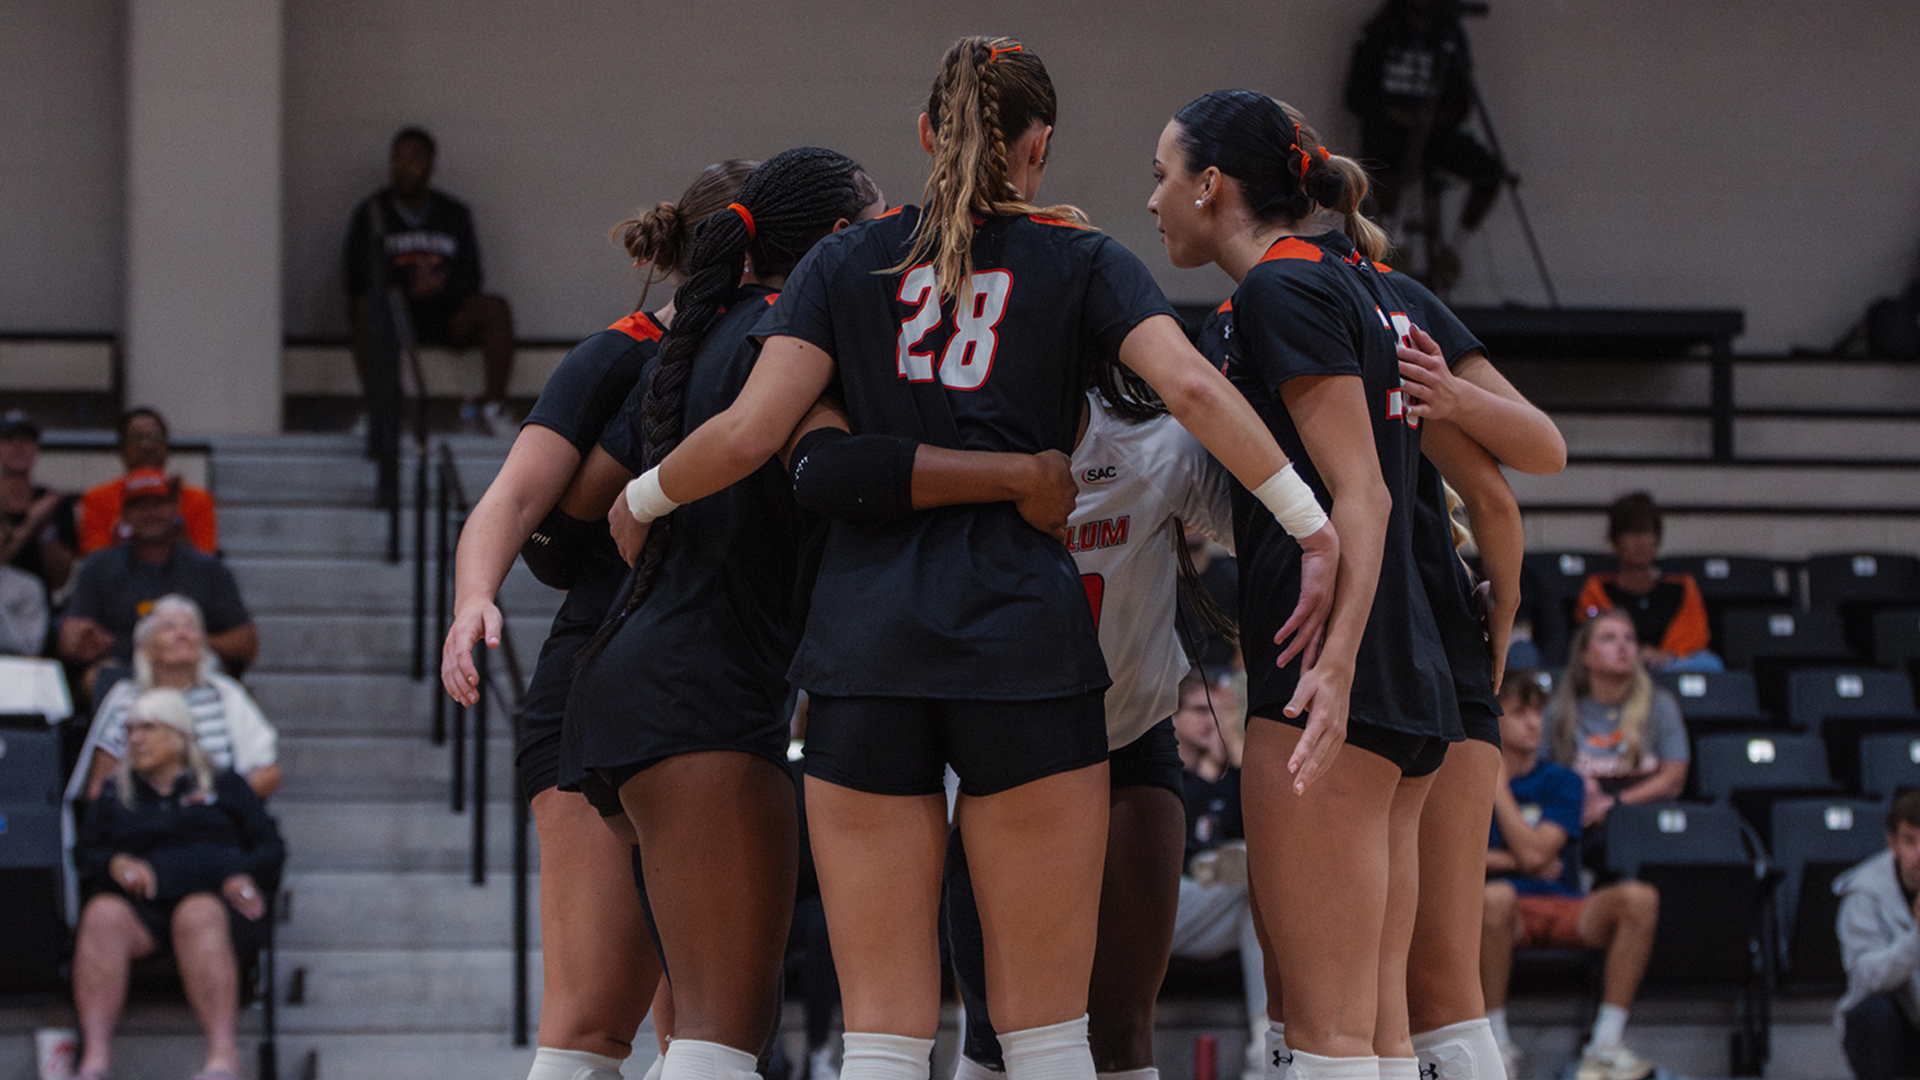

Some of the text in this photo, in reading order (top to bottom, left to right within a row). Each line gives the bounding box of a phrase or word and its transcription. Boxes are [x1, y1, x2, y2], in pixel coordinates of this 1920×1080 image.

[896, 261, 1013, 391] 28
[1087, 466, 1117, 482] SAC
[1064, 515, 1130, 553] LUM
